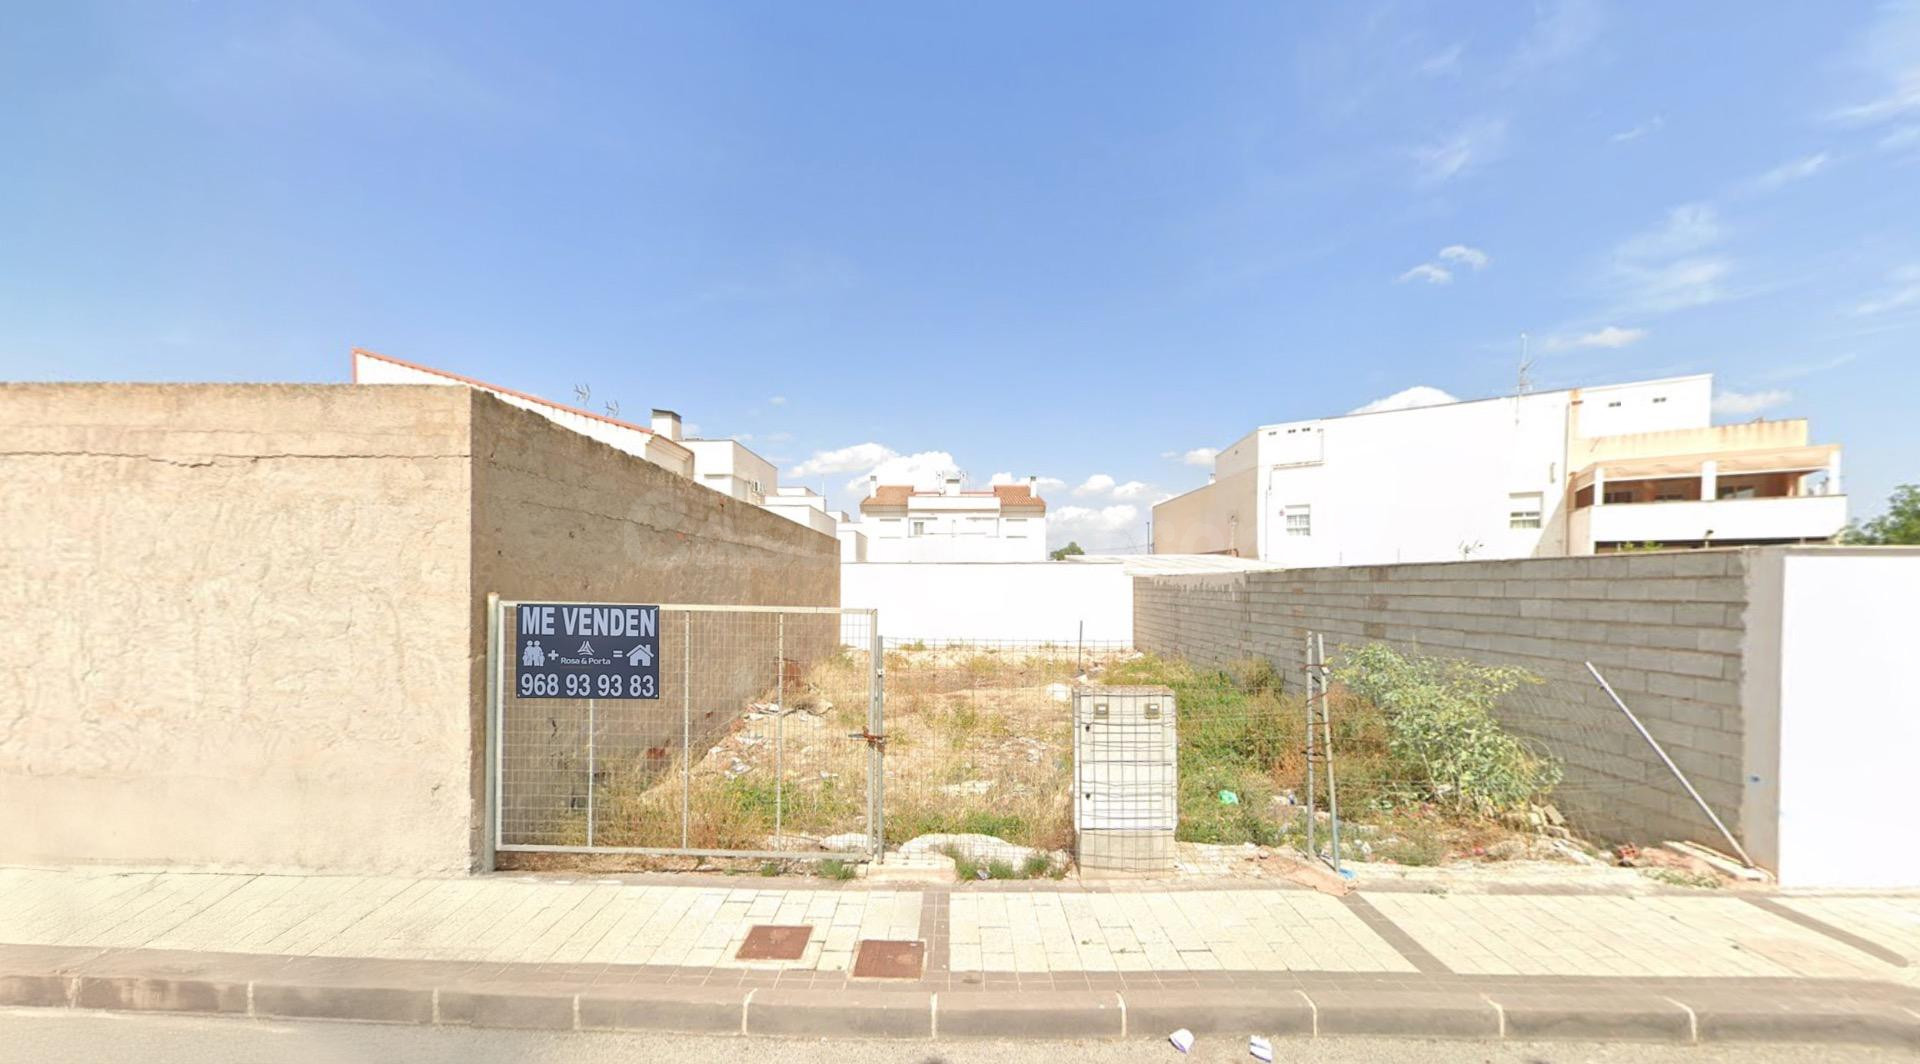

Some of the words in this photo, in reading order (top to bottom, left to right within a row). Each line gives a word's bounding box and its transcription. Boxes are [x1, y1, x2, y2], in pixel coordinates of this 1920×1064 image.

[522, 606, 555, 635] ME
[562, 607, 656, 637] VENDEN
[560, 657, 580, 665] Rosa
[581, 657, 588, 665] &
[588, 657, 611, 665] Porta
[521, 673, 559, 696] 968
[565, 673, 591, 697] 93
[597, 674, 623, 697] 93
[629, 674, 655, 697] 83
